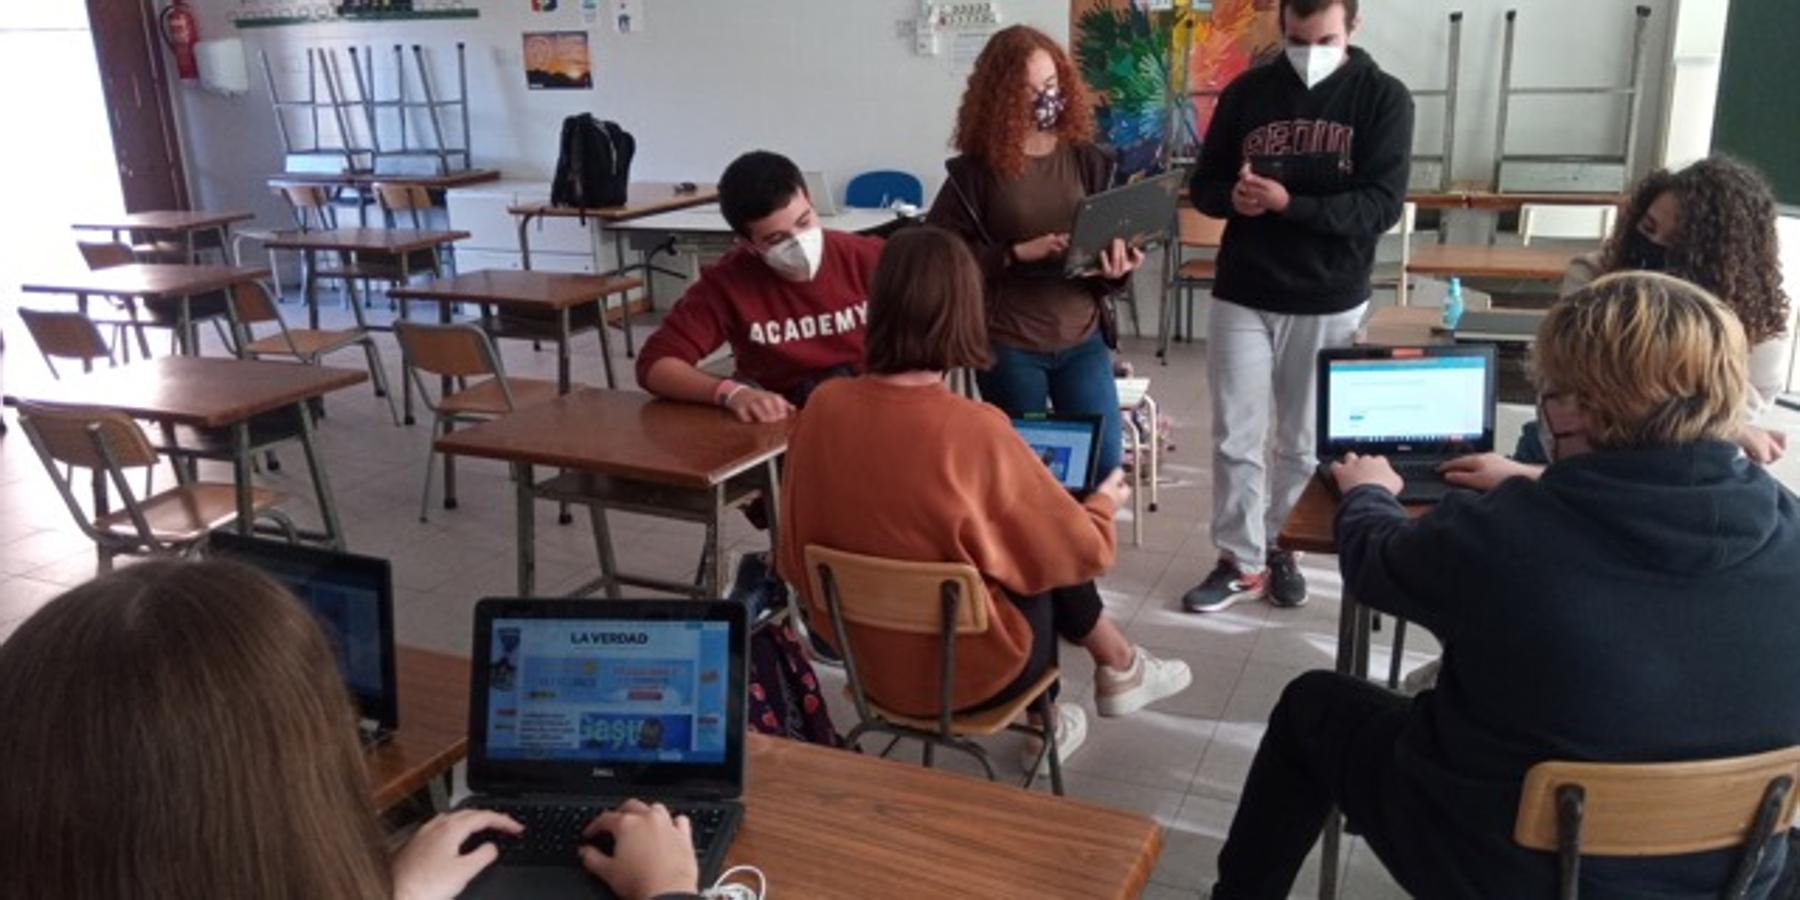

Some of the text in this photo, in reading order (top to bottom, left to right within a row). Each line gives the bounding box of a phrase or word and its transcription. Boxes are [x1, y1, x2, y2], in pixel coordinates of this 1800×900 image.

[750, 301, 868, 344] ACADEMY
[570, 632, 648, 645] LA VERDAD
